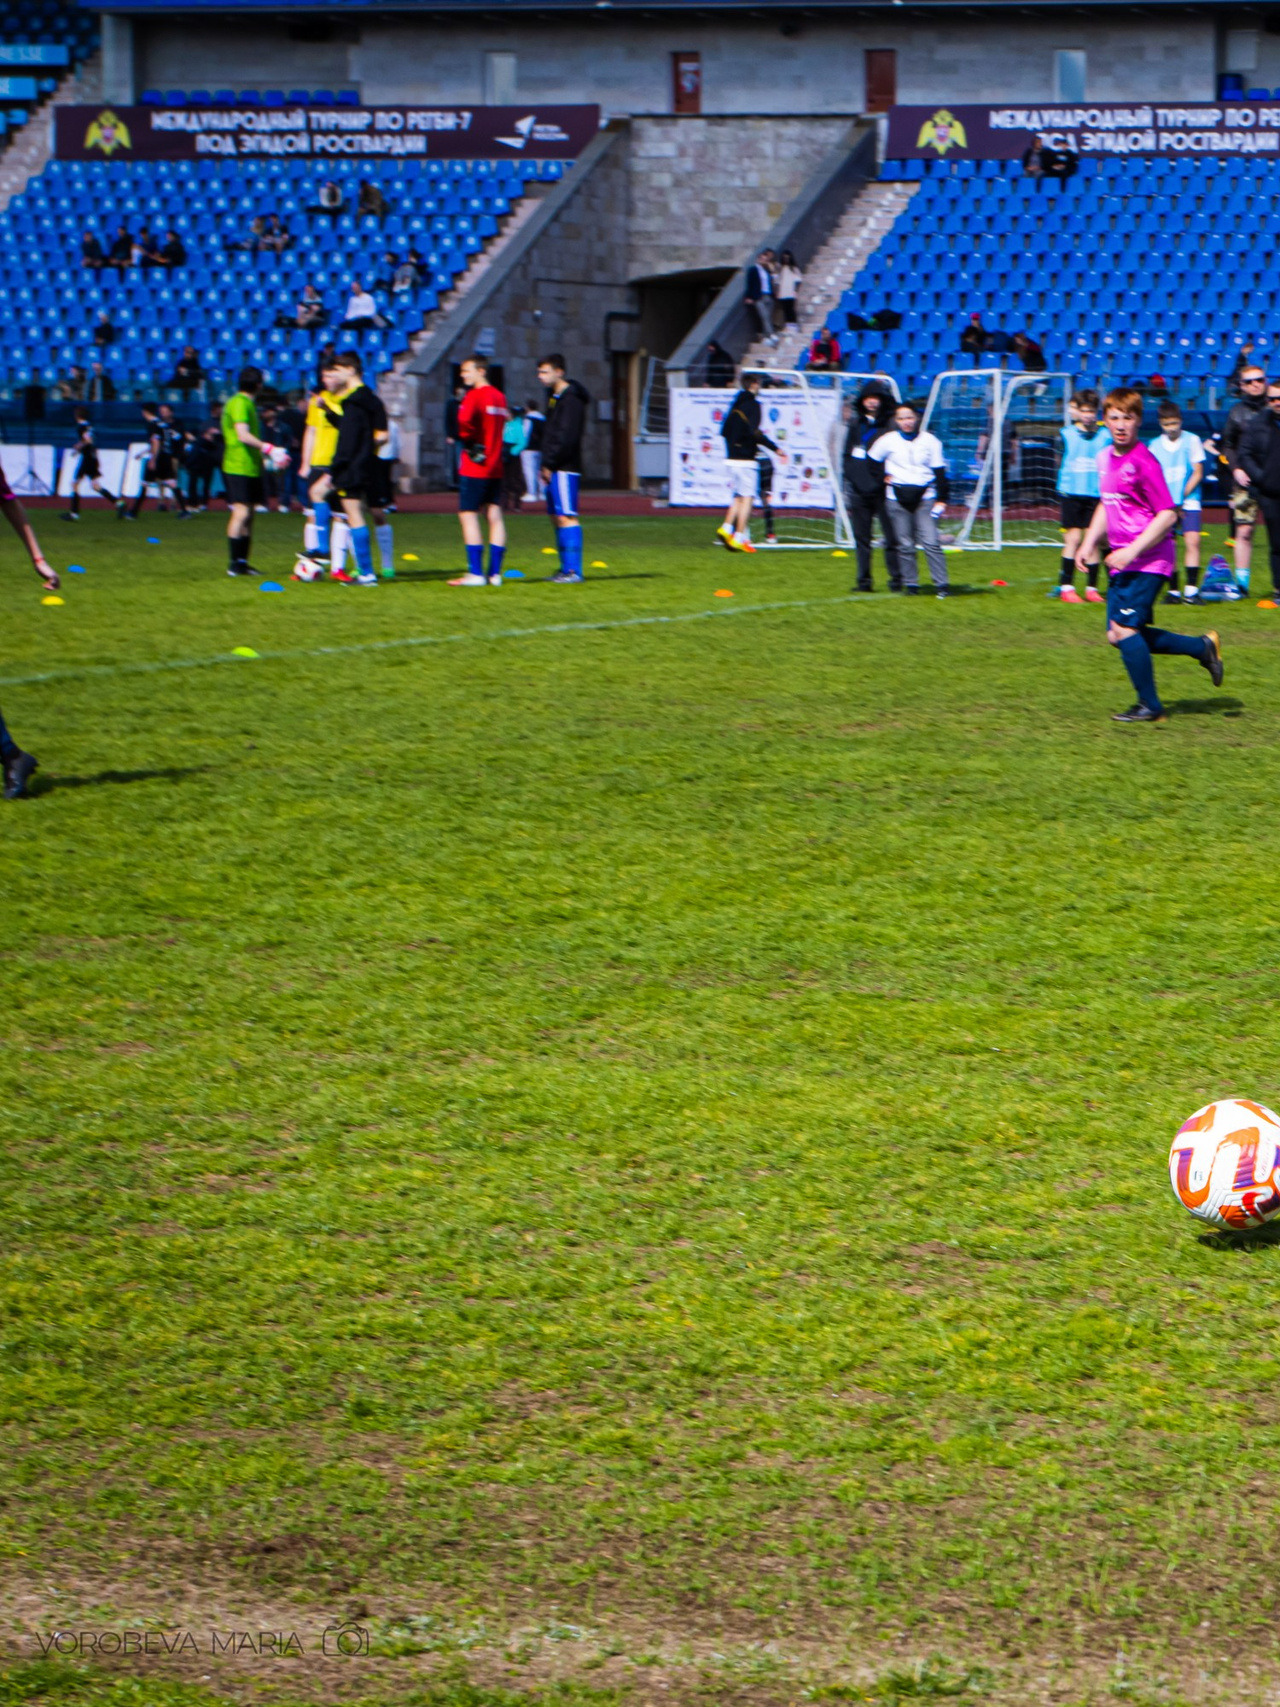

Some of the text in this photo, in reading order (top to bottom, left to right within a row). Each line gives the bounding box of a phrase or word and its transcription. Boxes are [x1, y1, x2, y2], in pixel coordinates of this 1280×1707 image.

[151, 108, 472, 132] МЕЖДУНАРОДНЫЙ ТУРНИР ПО РЕГБИ-7
[989, 105, 1153, 130] МЕЖДУНАРОДНЫЙ
[1155, 108, 1223, 127] ТУРНИР
[1225, 108, 1256, 127] ПО
[195, 131, 428, 155] ПОД ЭГИДОЙ РОСГВАРДИИ
[1080, 129, 1156, 153] ЭГИДОЙ
[1158, 132, 1280, 153] РОСГВАРДИИ
